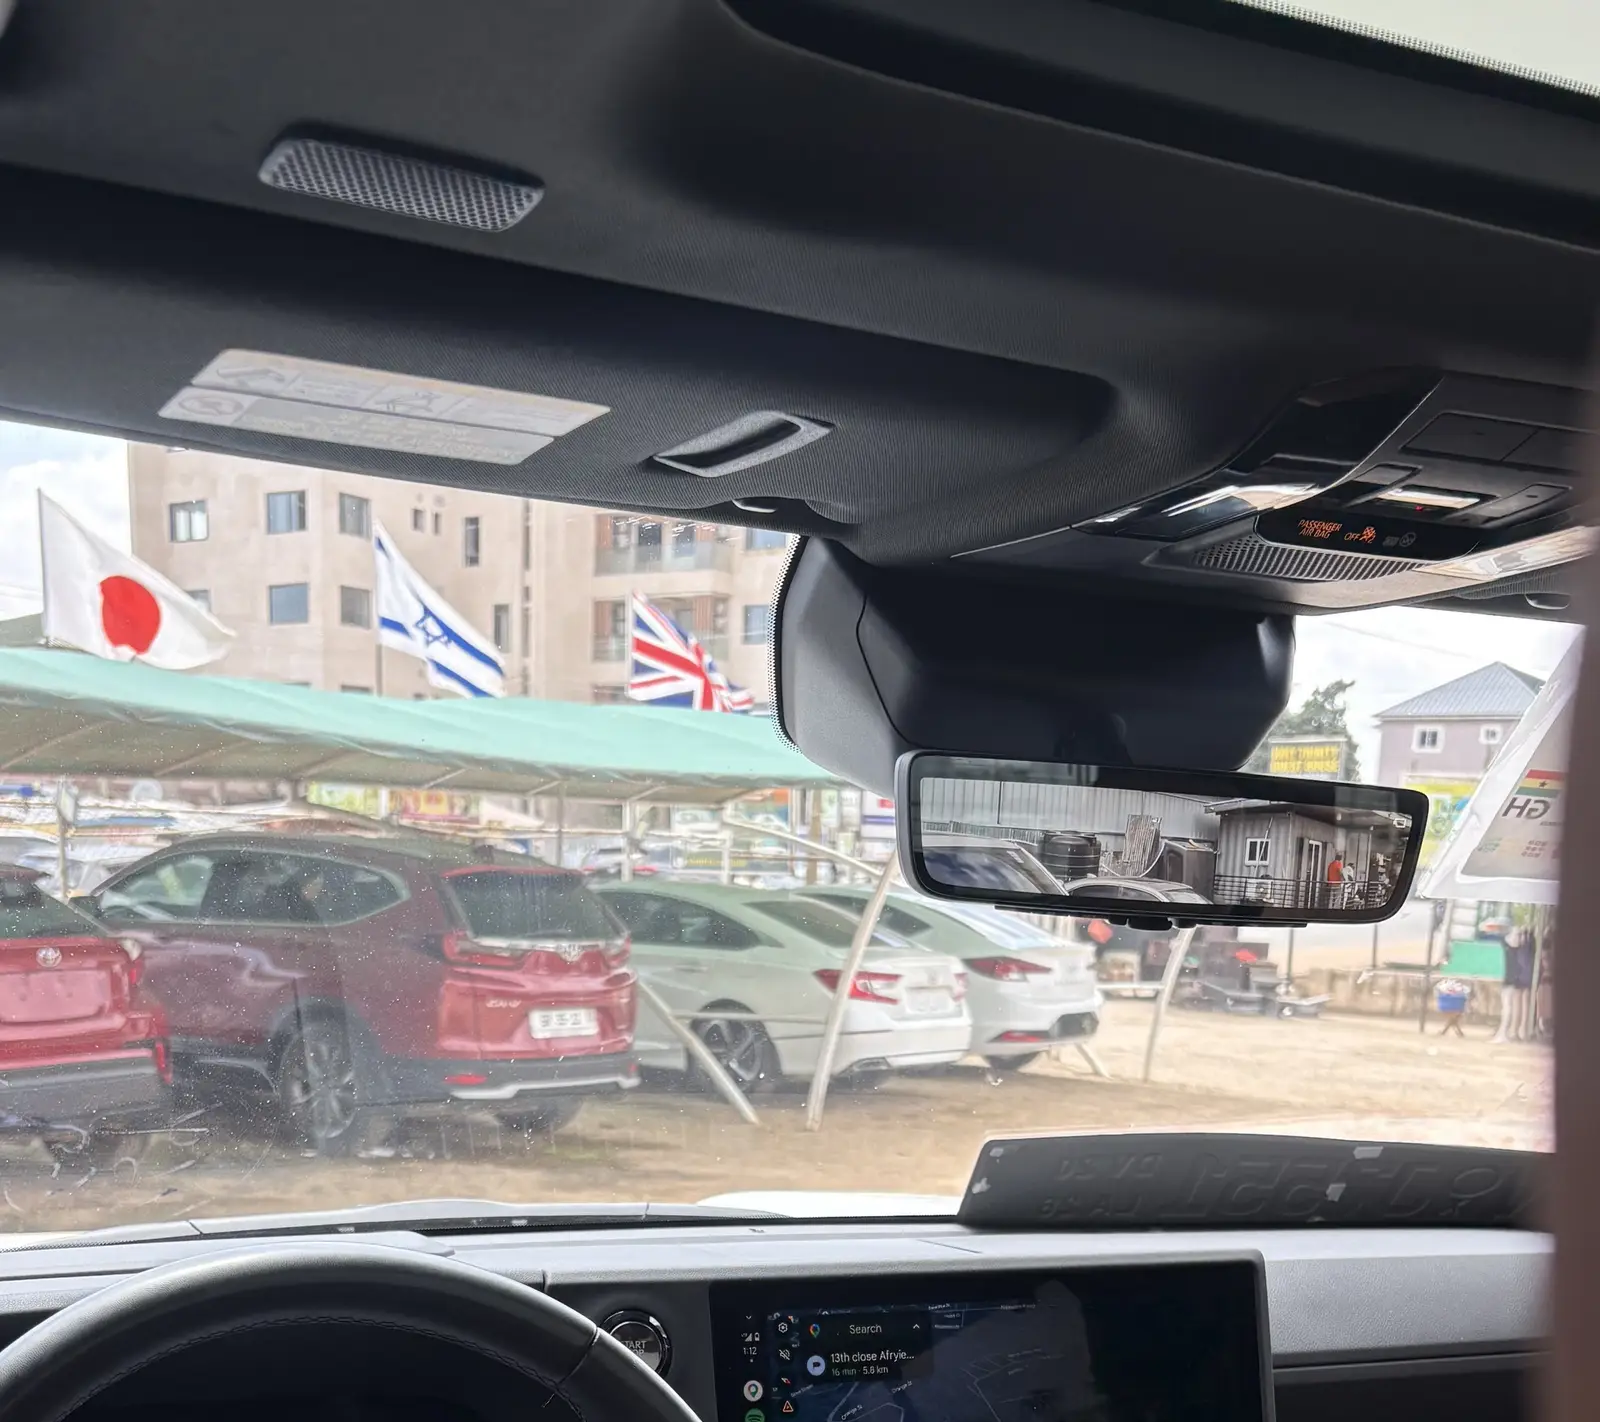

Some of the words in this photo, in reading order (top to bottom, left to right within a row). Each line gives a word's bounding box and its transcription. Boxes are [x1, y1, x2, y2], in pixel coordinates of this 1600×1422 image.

[1299, 519, 1343, 532] PASSENGER
[1299, 526, 1314, 537] AIR
[1314, 528, 1331, 539] BAG
[1344, 532, 1360, 541] OFF
[849, 1324, 882, 1334] Search
[620, 1340, 647, 1349] TART
[743, 1346, 757, 1355] 1:12
[831, 1353, 850, 1363] 13th
[851, 1352, 877, 1362] close
[832, 1368, 840, 1376] 16
[876, 1366, 889, 1375] km
